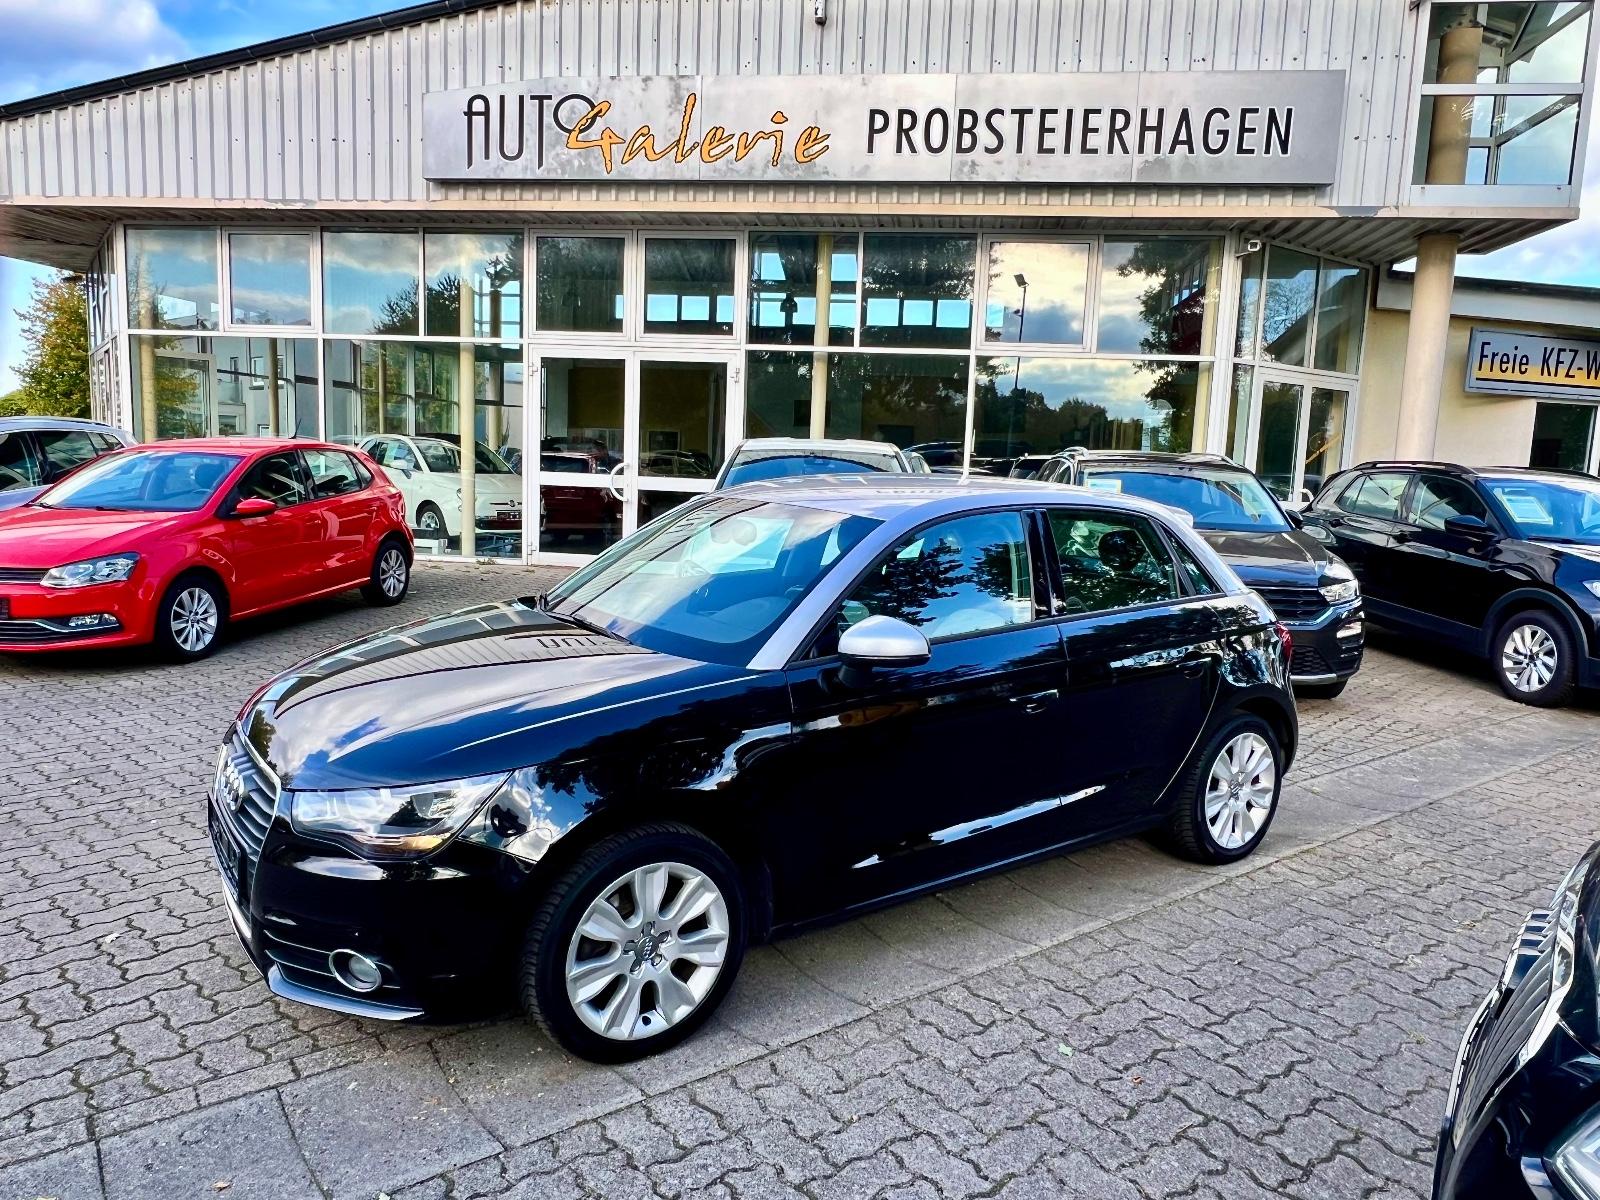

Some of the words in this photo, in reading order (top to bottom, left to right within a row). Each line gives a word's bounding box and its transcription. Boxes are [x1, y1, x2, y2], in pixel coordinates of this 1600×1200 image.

[566, 93, 831, 174] Galerie
[866, 107, 1295, 156] PROBSTEIERHAGEN
[1478, 341, 1530, 375] Freie
